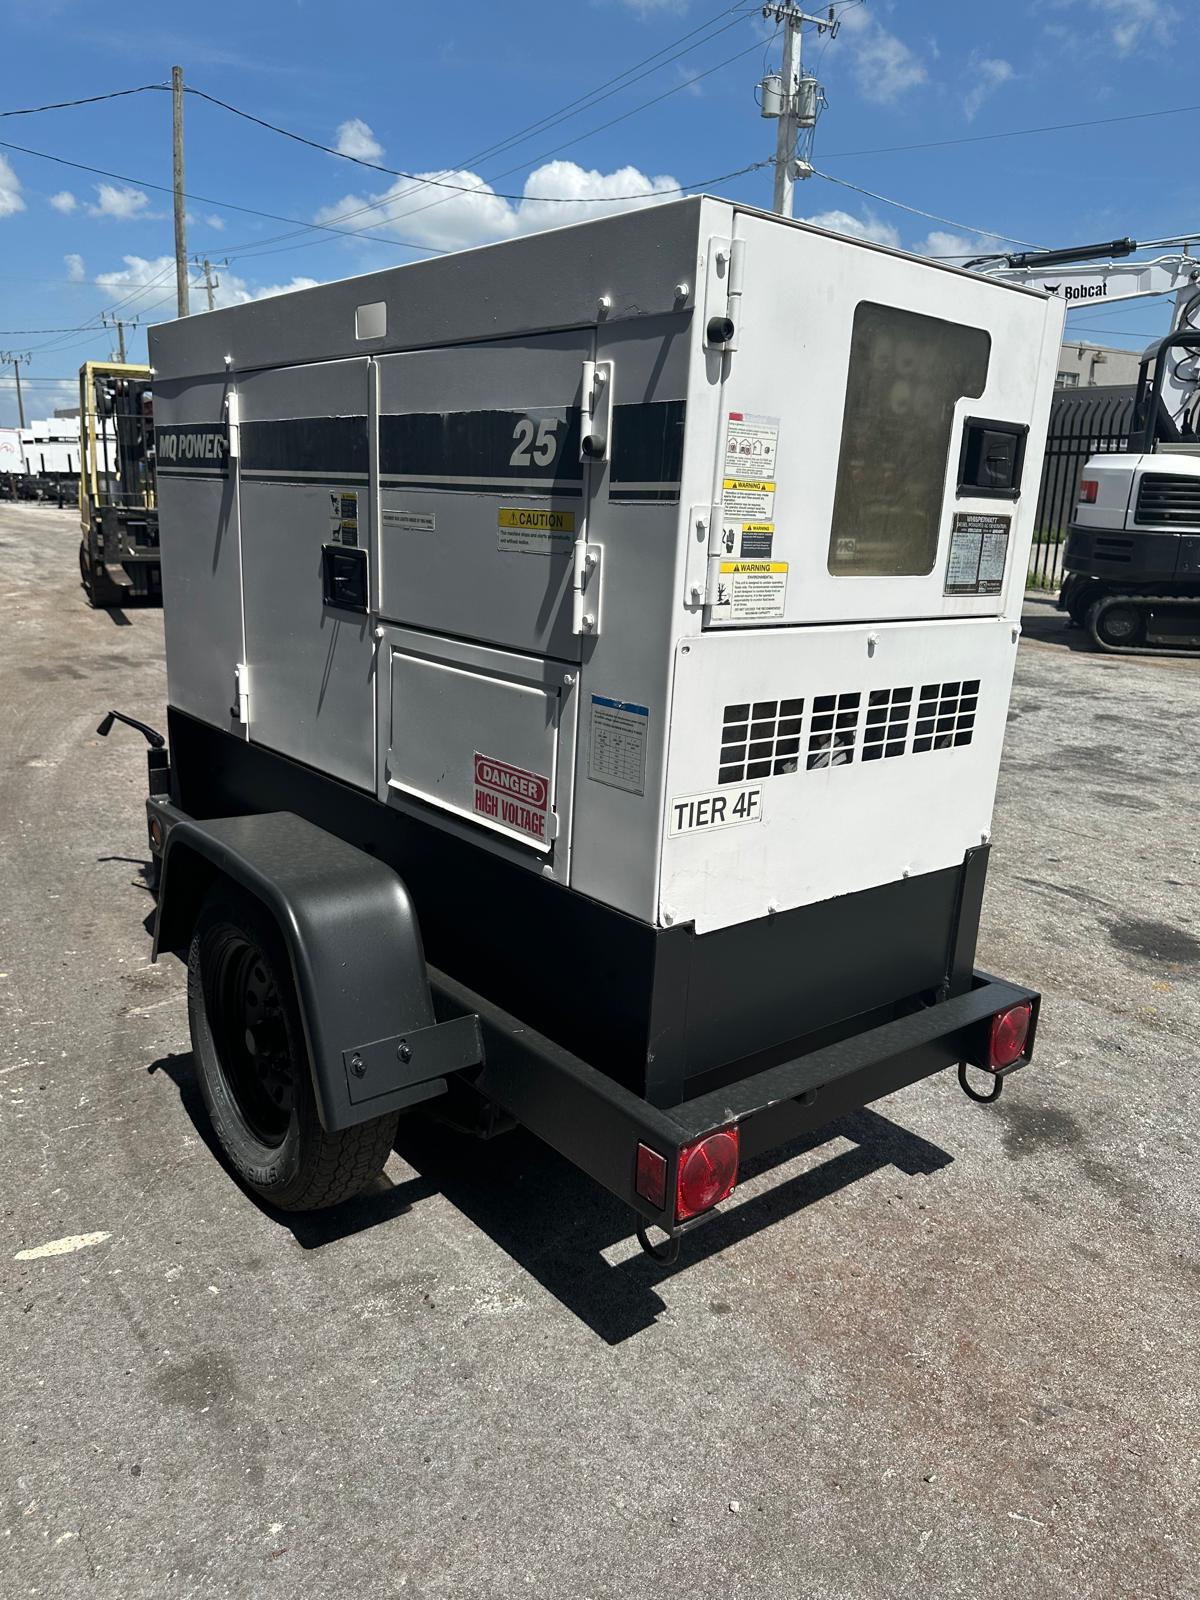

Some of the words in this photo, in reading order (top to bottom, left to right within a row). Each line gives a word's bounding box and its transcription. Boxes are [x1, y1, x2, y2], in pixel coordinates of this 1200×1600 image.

[1065, 283, 1107, 300] Bobcat
[159, 434, 177, 462] MQ
[178, 434, 224, 459] POWER
[509, 418, 558, 467] 25
[738, 482, 761, 490] WARNING
[519, 512, 564, 528] CAUTION
[741, 564, 770, 572] WARNING
[483, 765, 538, 799] DANGER
[475, 789, 498, 818] HIGH
[501, 798, 545, 837] VOLTAGE
[674, 796, 727, 830] TIER
[732, 790, 760, 818] 4F
